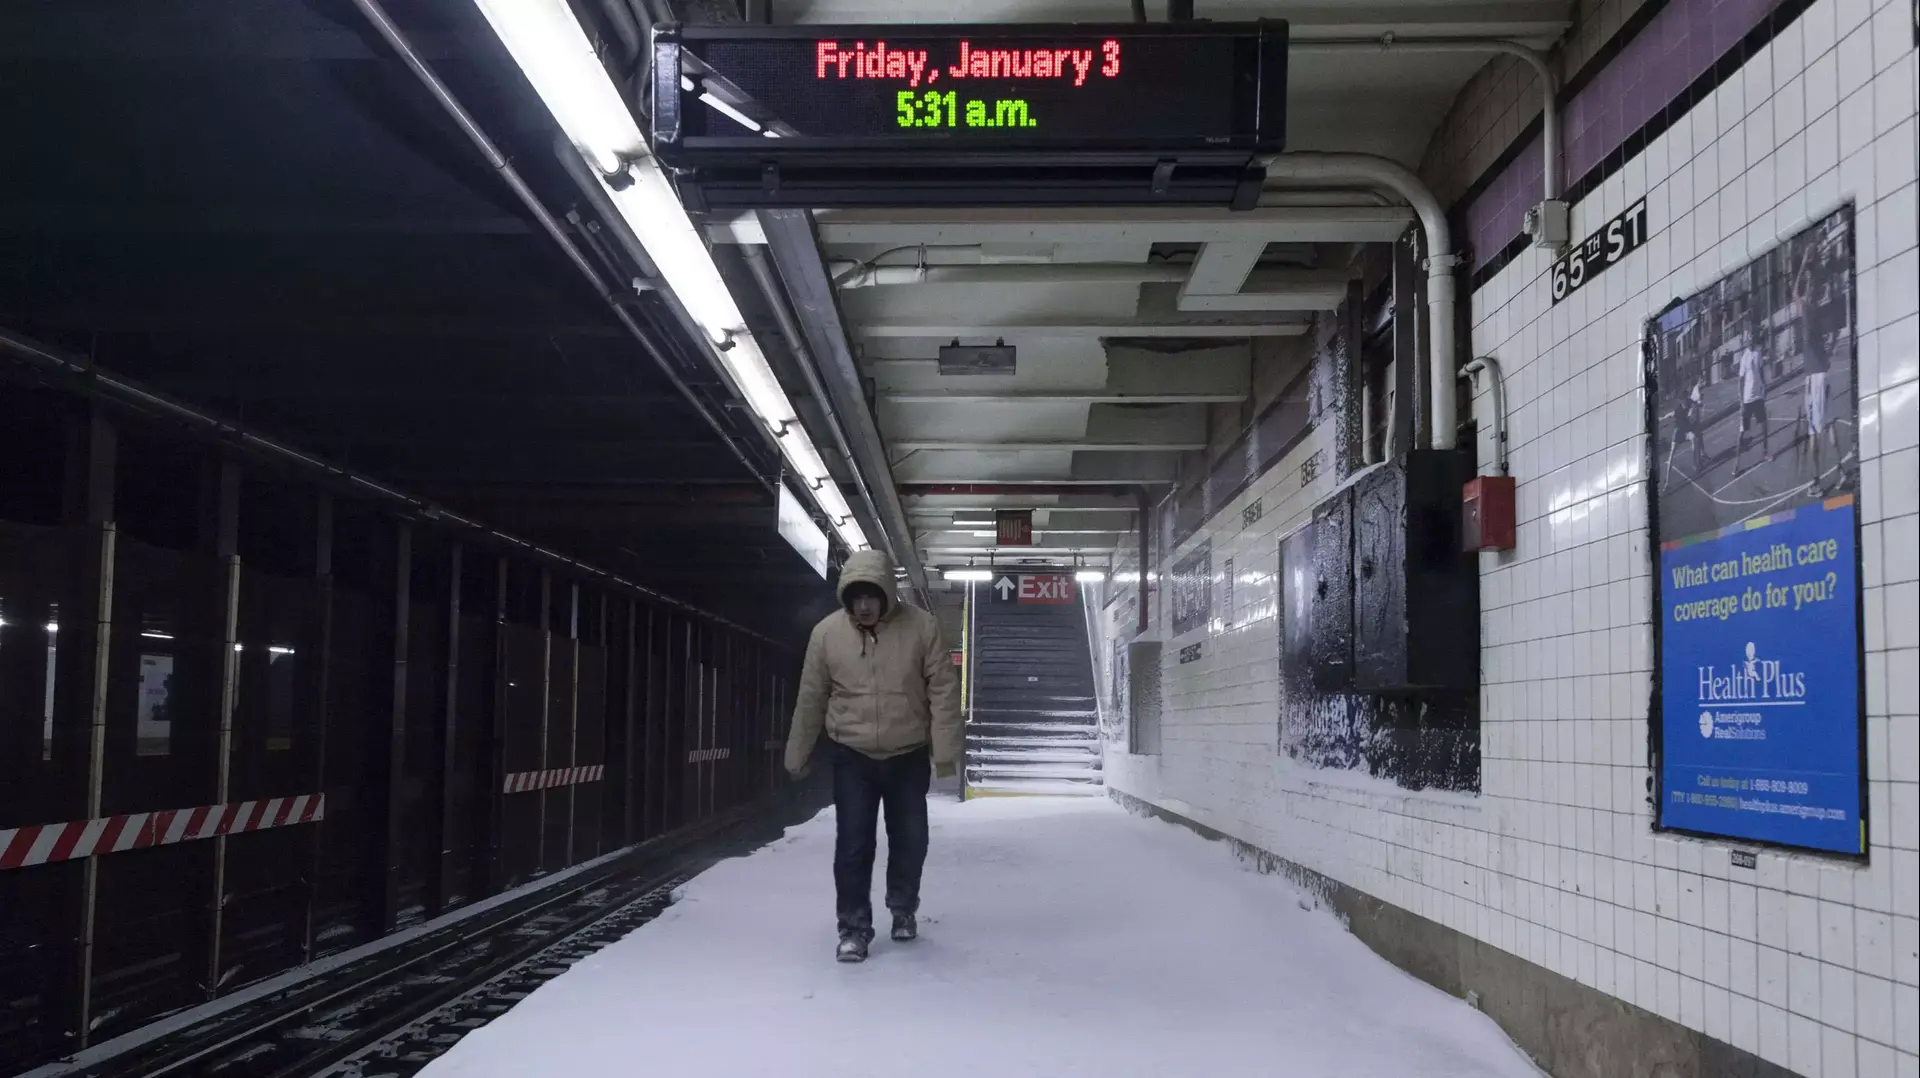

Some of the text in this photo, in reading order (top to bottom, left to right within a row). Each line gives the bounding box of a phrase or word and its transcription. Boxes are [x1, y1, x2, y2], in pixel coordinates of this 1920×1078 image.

[817, 40, 1120, 87] Friday, January 3
[897, 91, 1036, 127] 5:31 a.m.
[1552, 200, 1645, 300] 65TH ST
[1672, 538, 1838, 589] What can health care
[1018, 575, 1069, 599] Exit
[1673, 571, 1837, 622] coverage do for you?
[1698, 659, 1806, 700] Health Plus
[1714, 726, 1767, 740] RealSolutions
[1715, 711, 1762, 726] Amerigroup
[1697, 774, 1711, 787] Call
